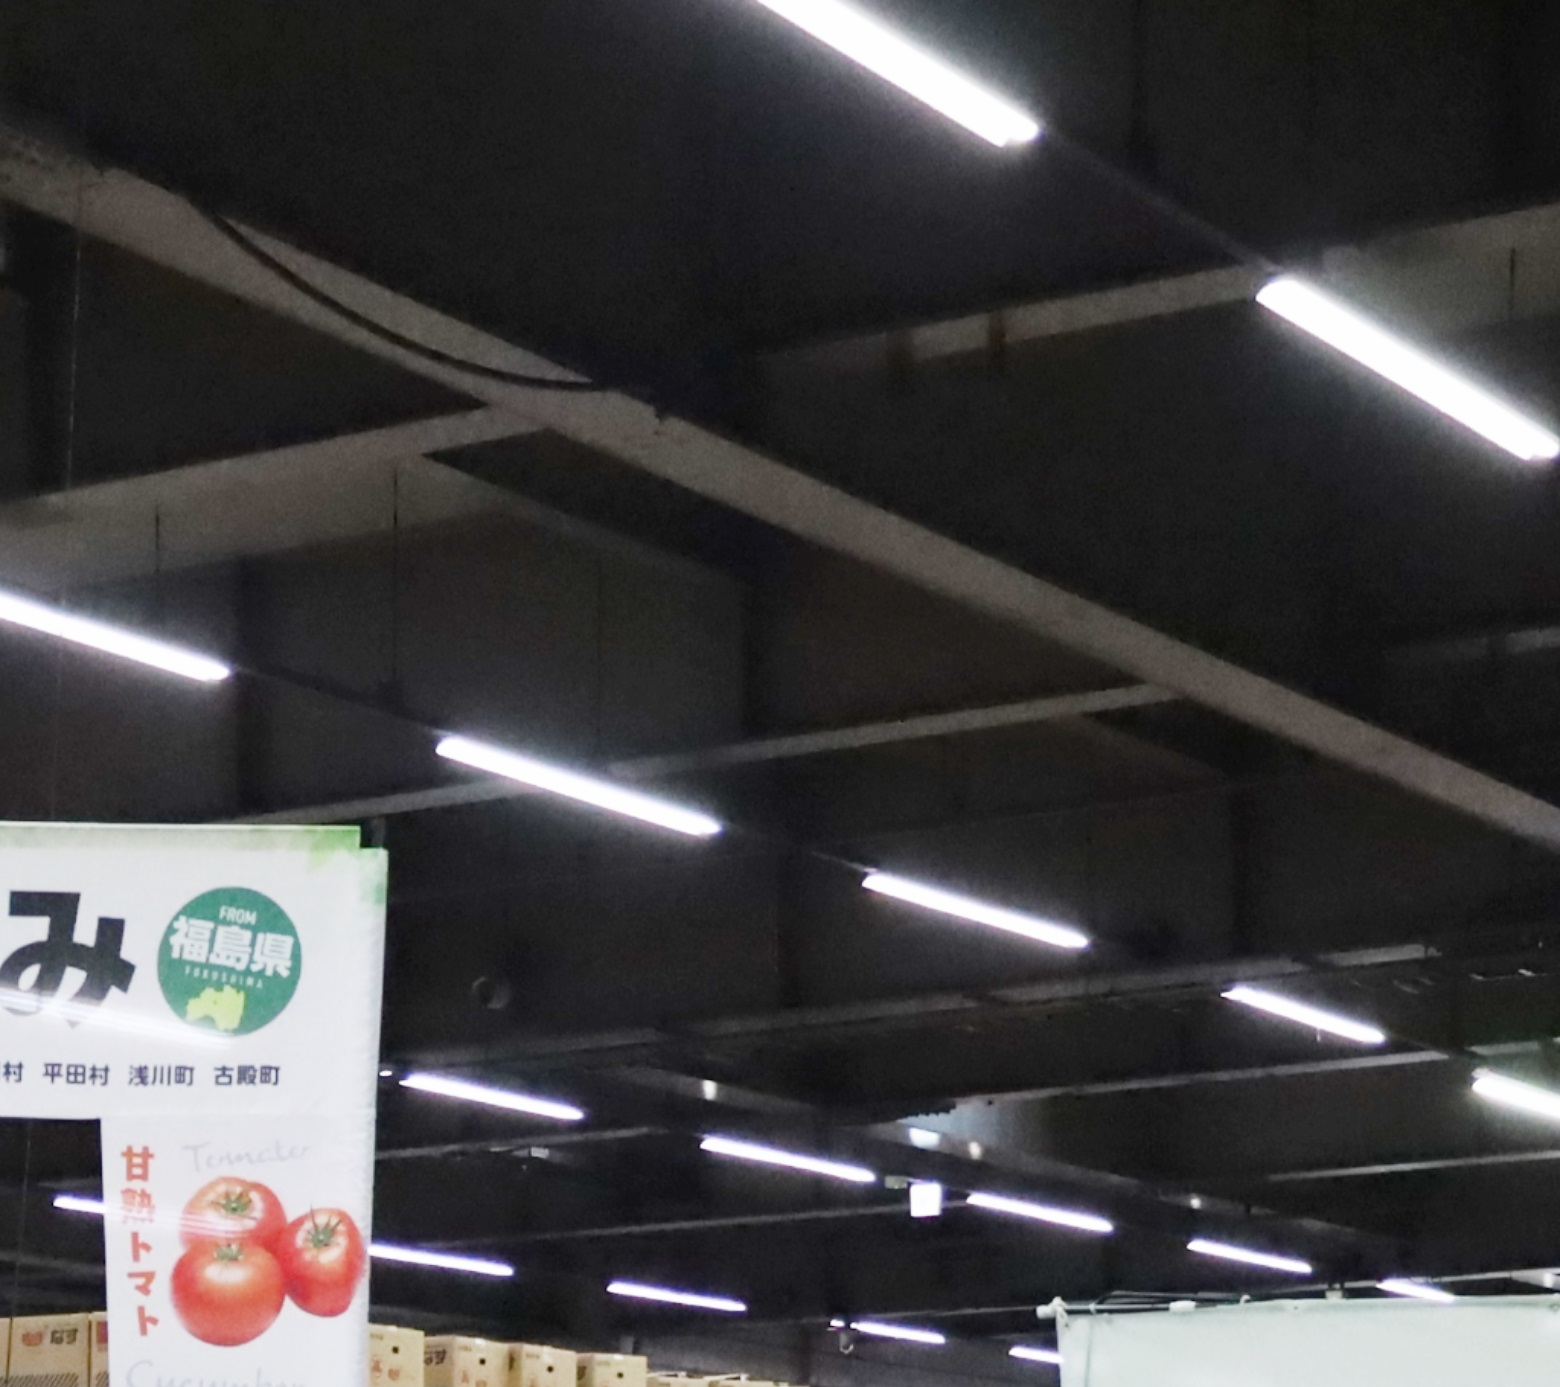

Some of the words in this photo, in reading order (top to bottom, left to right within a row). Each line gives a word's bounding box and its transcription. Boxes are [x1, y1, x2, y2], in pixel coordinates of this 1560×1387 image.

[219, 905, 257, 925] FROM
[169, 915, 294, 978] 福島県
[185, 965, 263, 988] FUKUSHIMA
[41, 1062, 111, 1087] 平田村
[127, 1063, 195, 1088] 浅川町
[212, 1063, 282, 1087] 古殿町
[120, 1145, 160, 1337] 甘熟トマト
